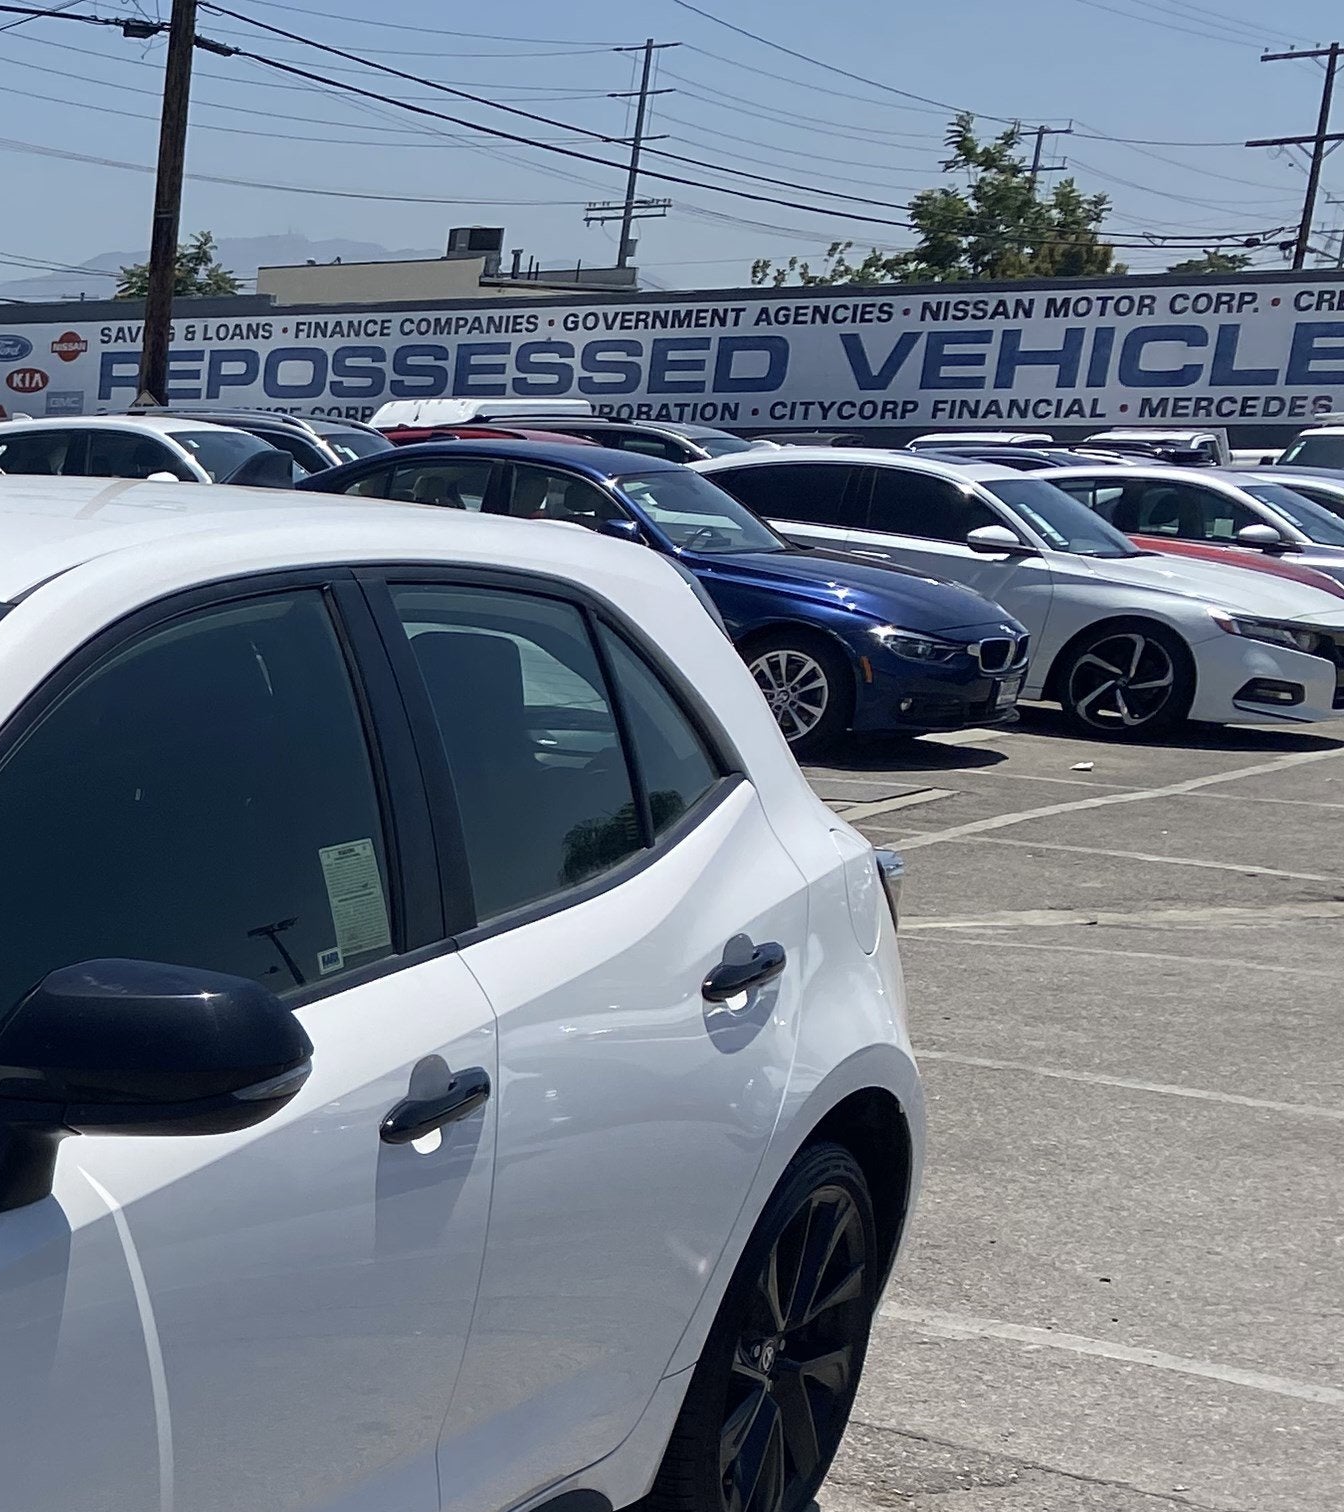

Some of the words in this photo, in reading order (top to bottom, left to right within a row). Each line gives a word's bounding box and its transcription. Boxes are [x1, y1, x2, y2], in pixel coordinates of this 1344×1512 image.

[184, 324, 196, 341] &
[202, 322, 273, 341] LOANS
[294, 319, 392, 339] FINANCE
[399, 314, 539, 336] COMPANIES
[563, 308, 746, 332] GOVERNMENT
[753, 303, 894, 327] AGENCIES
[920, 298, 1034, 321] NISSAN
[1044, 295, 1156, 318] MOTOR
[1169, 292, 1259, 315] CORP.
[53, 342, 86, 352] NISSAN
[98, 335, 790, 400] REPOSSESSED
[839, 322, 1344, 391] VEHICLE
[13, 372, 43, 388] KIA
[769, 400, 919, 421] CITYCORP
[931, 397, 1107, 419] FINANCIAL
[1138, 395, 1333, 419] MERCEDES
